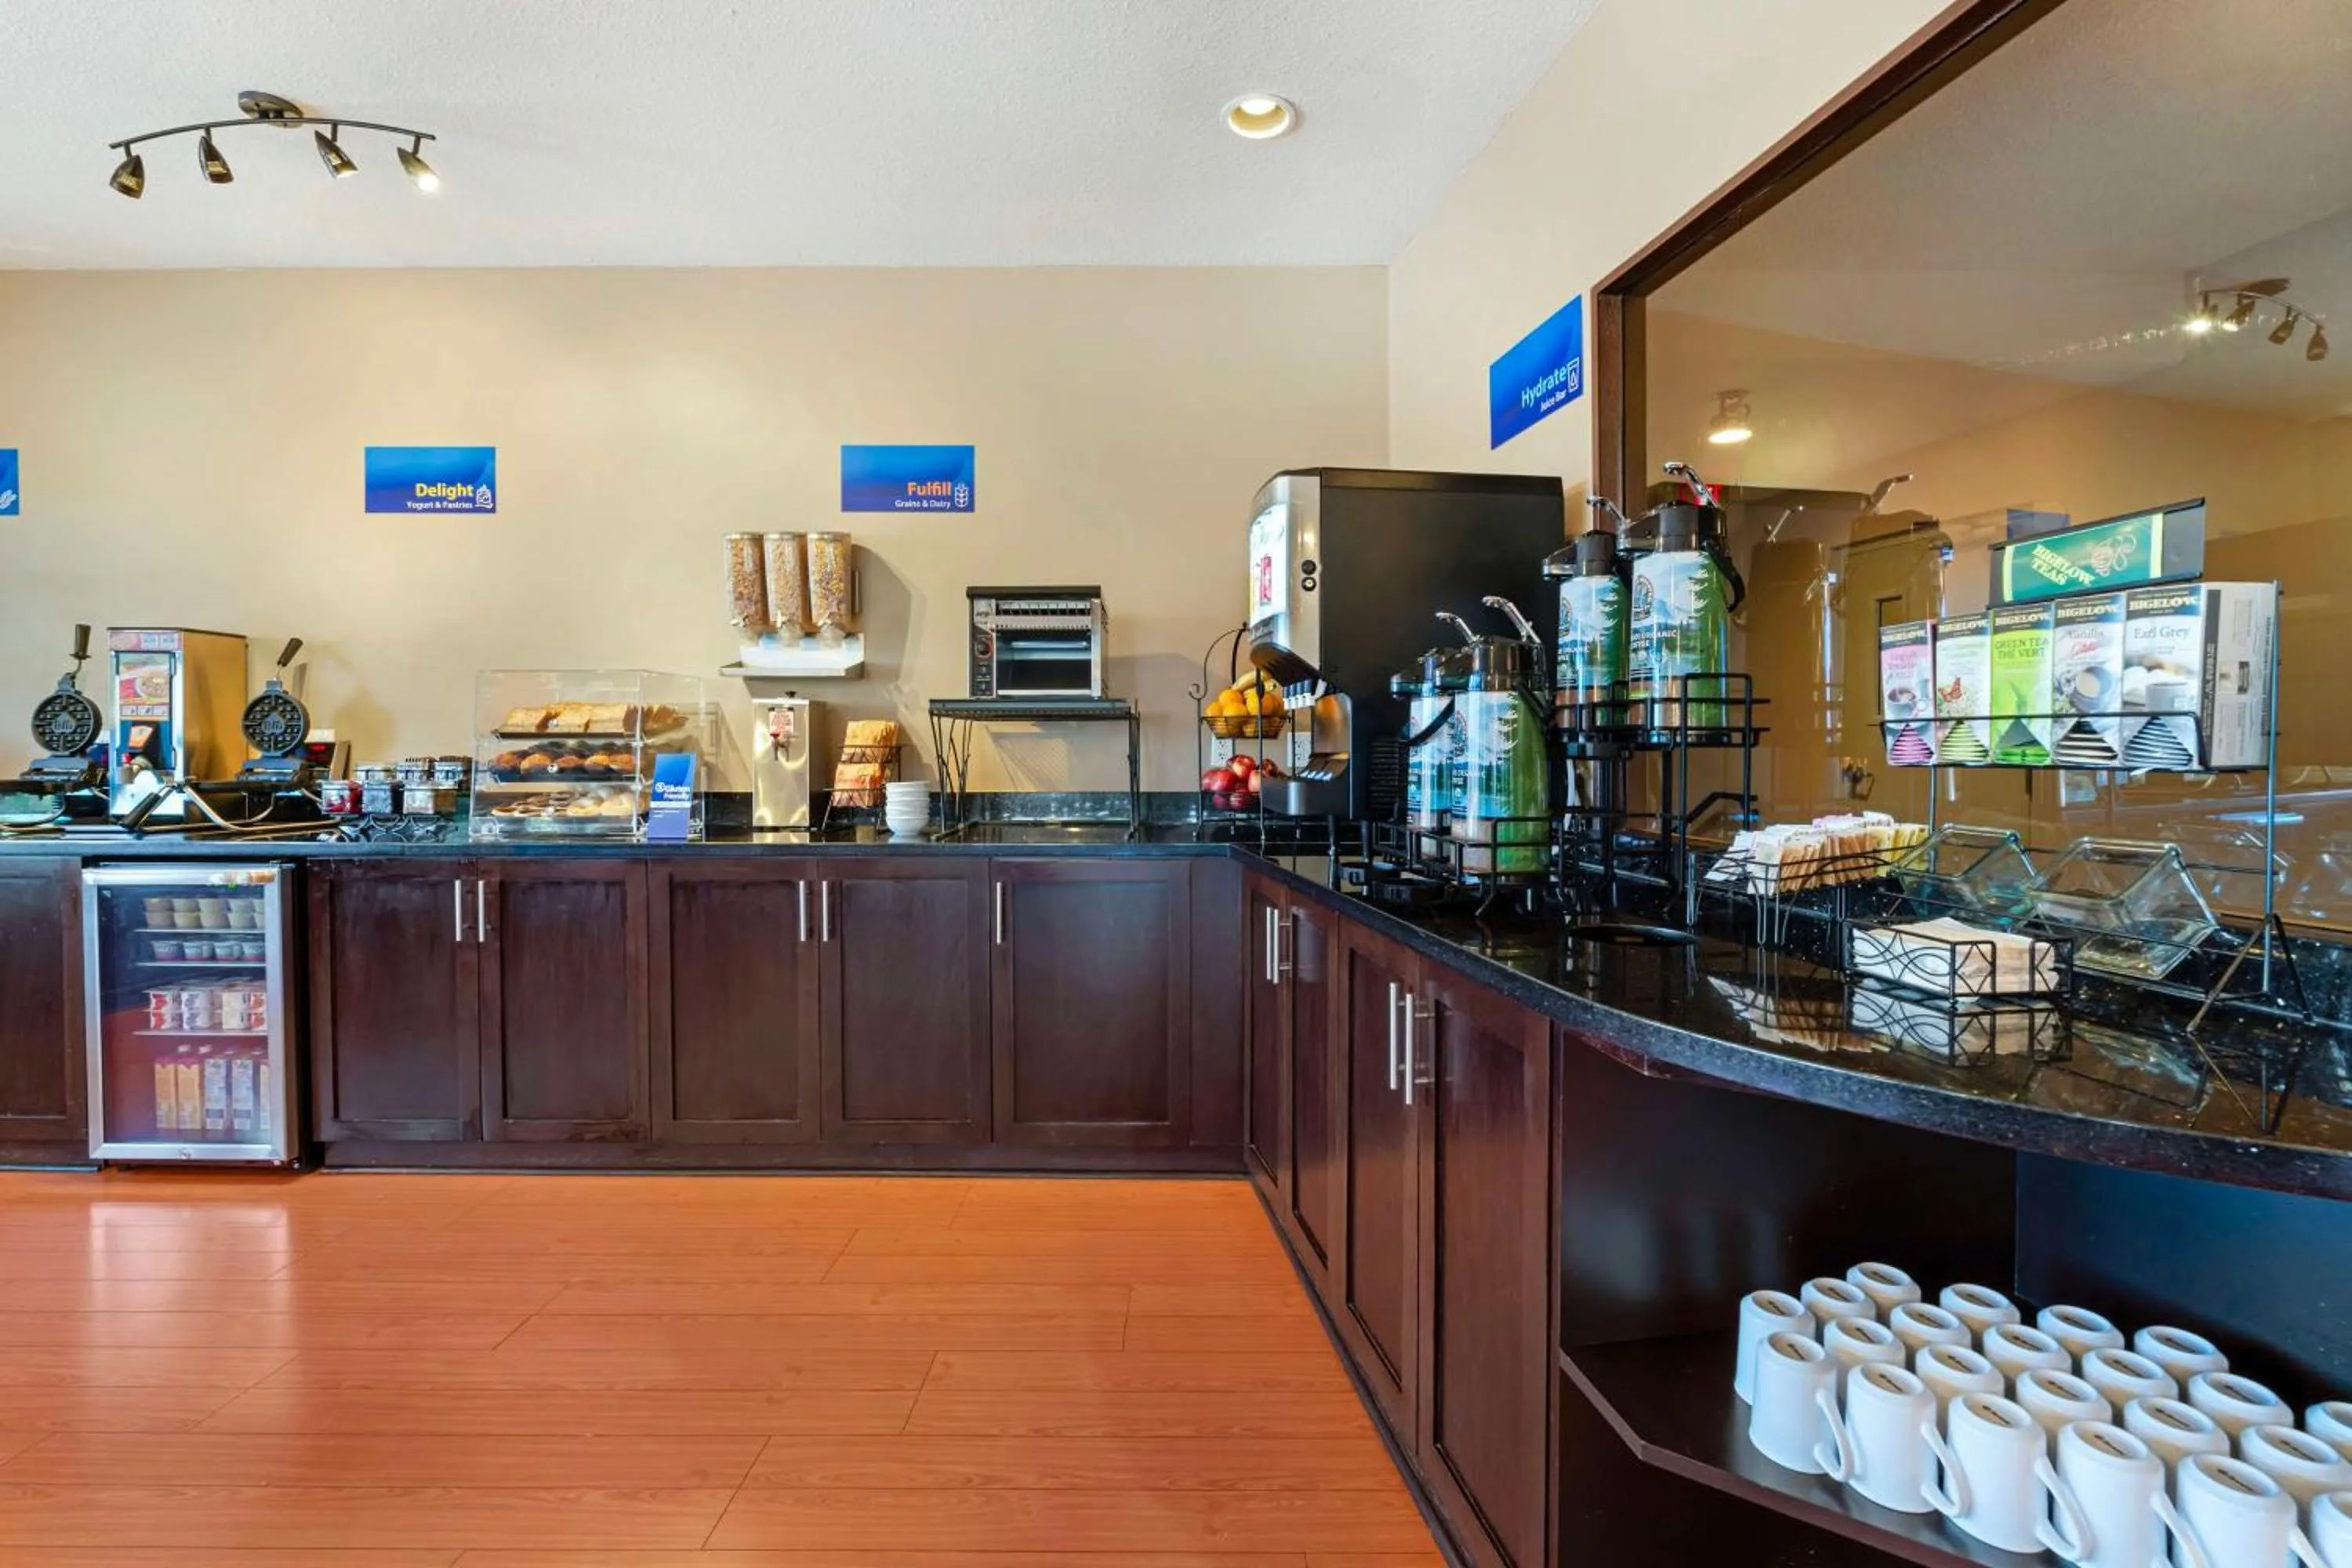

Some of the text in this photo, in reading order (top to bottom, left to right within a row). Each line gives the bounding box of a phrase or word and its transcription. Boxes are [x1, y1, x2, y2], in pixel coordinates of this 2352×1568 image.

[1522, 367, 1567, 408] Hydrate
[1540, 389, 1567, 412] Juice Bar
[415, 482, 474, 500] Delight
[906, 481, 952, 495] Fulfill
[406, 501, 434, 510] Yogurt
[895, 499, 920, 508] Grains
[929, 499, 951, 509] Dairy
[2032, 544, 2095, 586] BIGELOW
[2032, 557, 2067, 585] TEAS
[2129, 596, 2200, 610] BIGELOW
[2057, 604, 2121, 618] BIGELOW
[2134, 626, 2190, 641] Earl Grey
[1994, 637, 2049, 650] GREEN TEA
